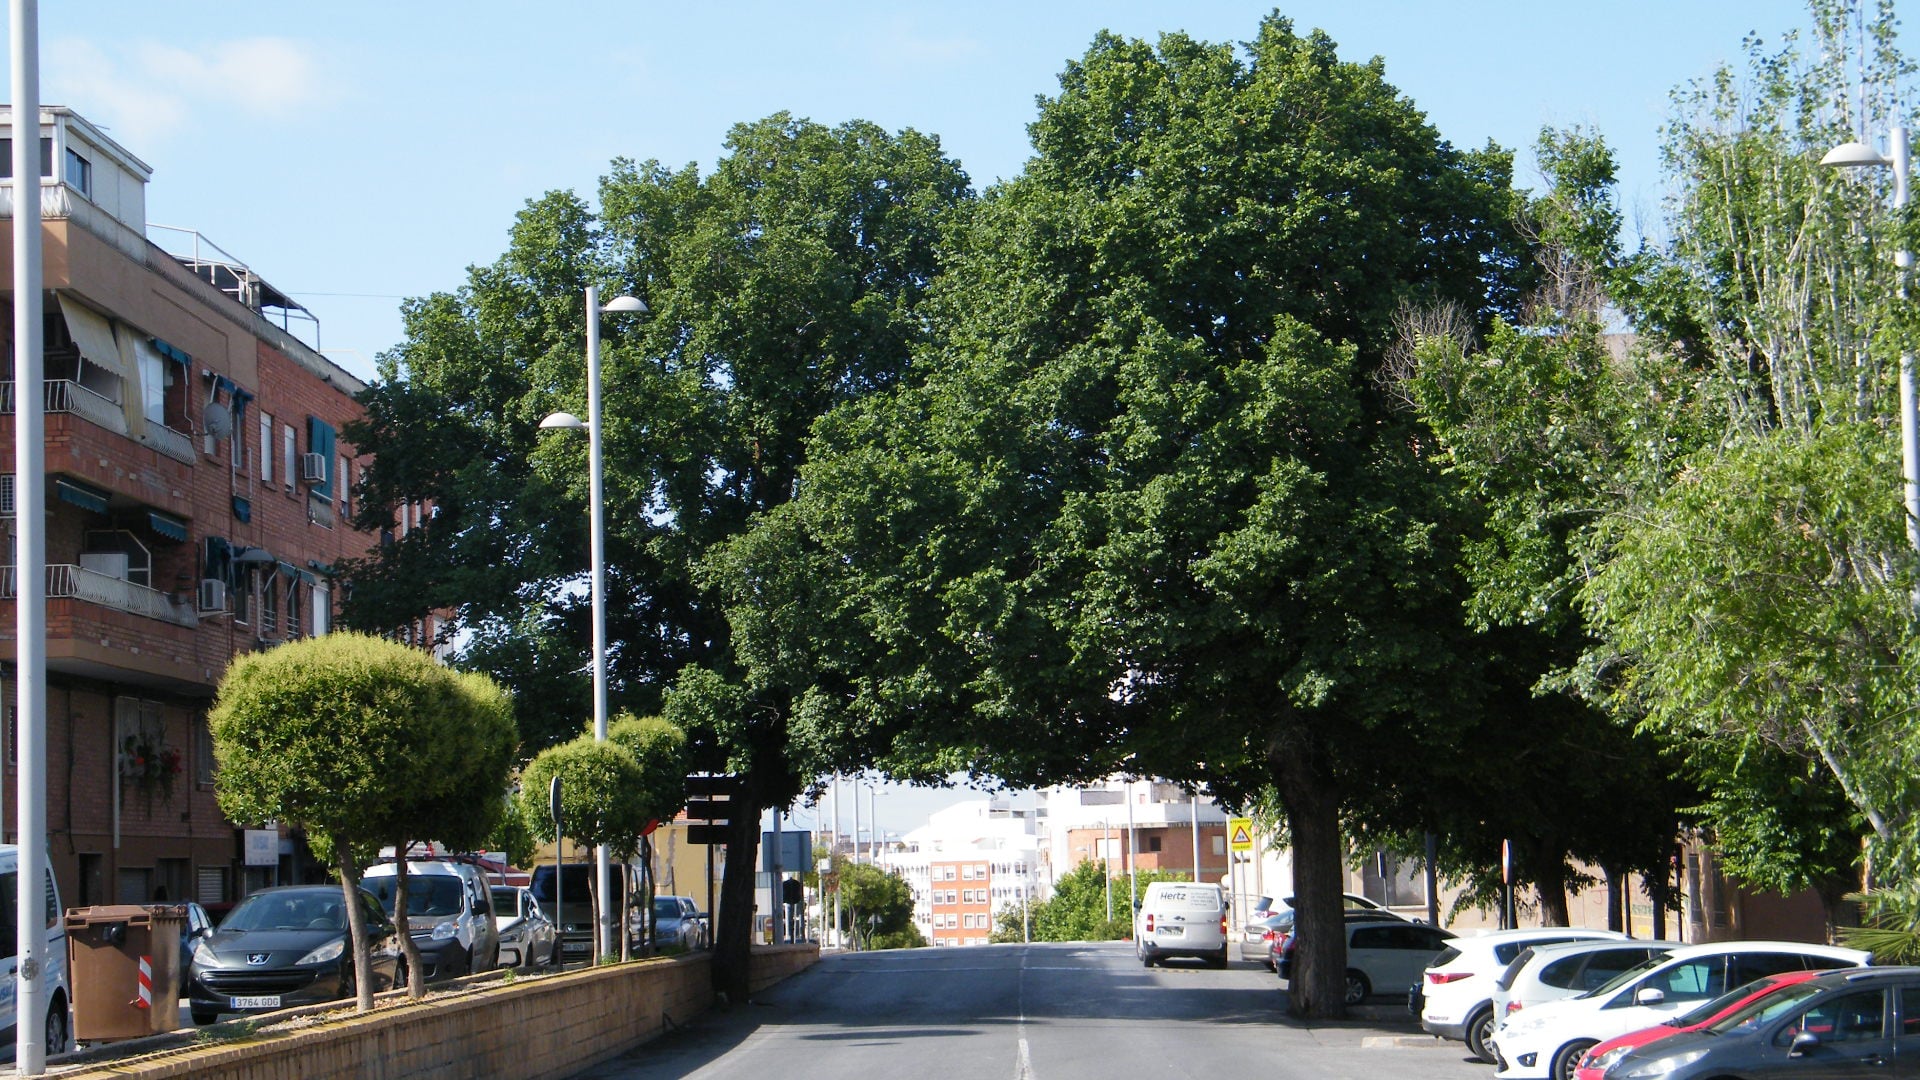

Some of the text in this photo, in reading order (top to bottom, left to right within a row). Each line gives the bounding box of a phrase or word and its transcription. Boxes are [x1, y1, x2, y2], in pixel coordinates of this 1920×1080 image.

[1160, 892, 1186, 900] Hertz
[237, 997, 279, 1007] 3764 GDG
